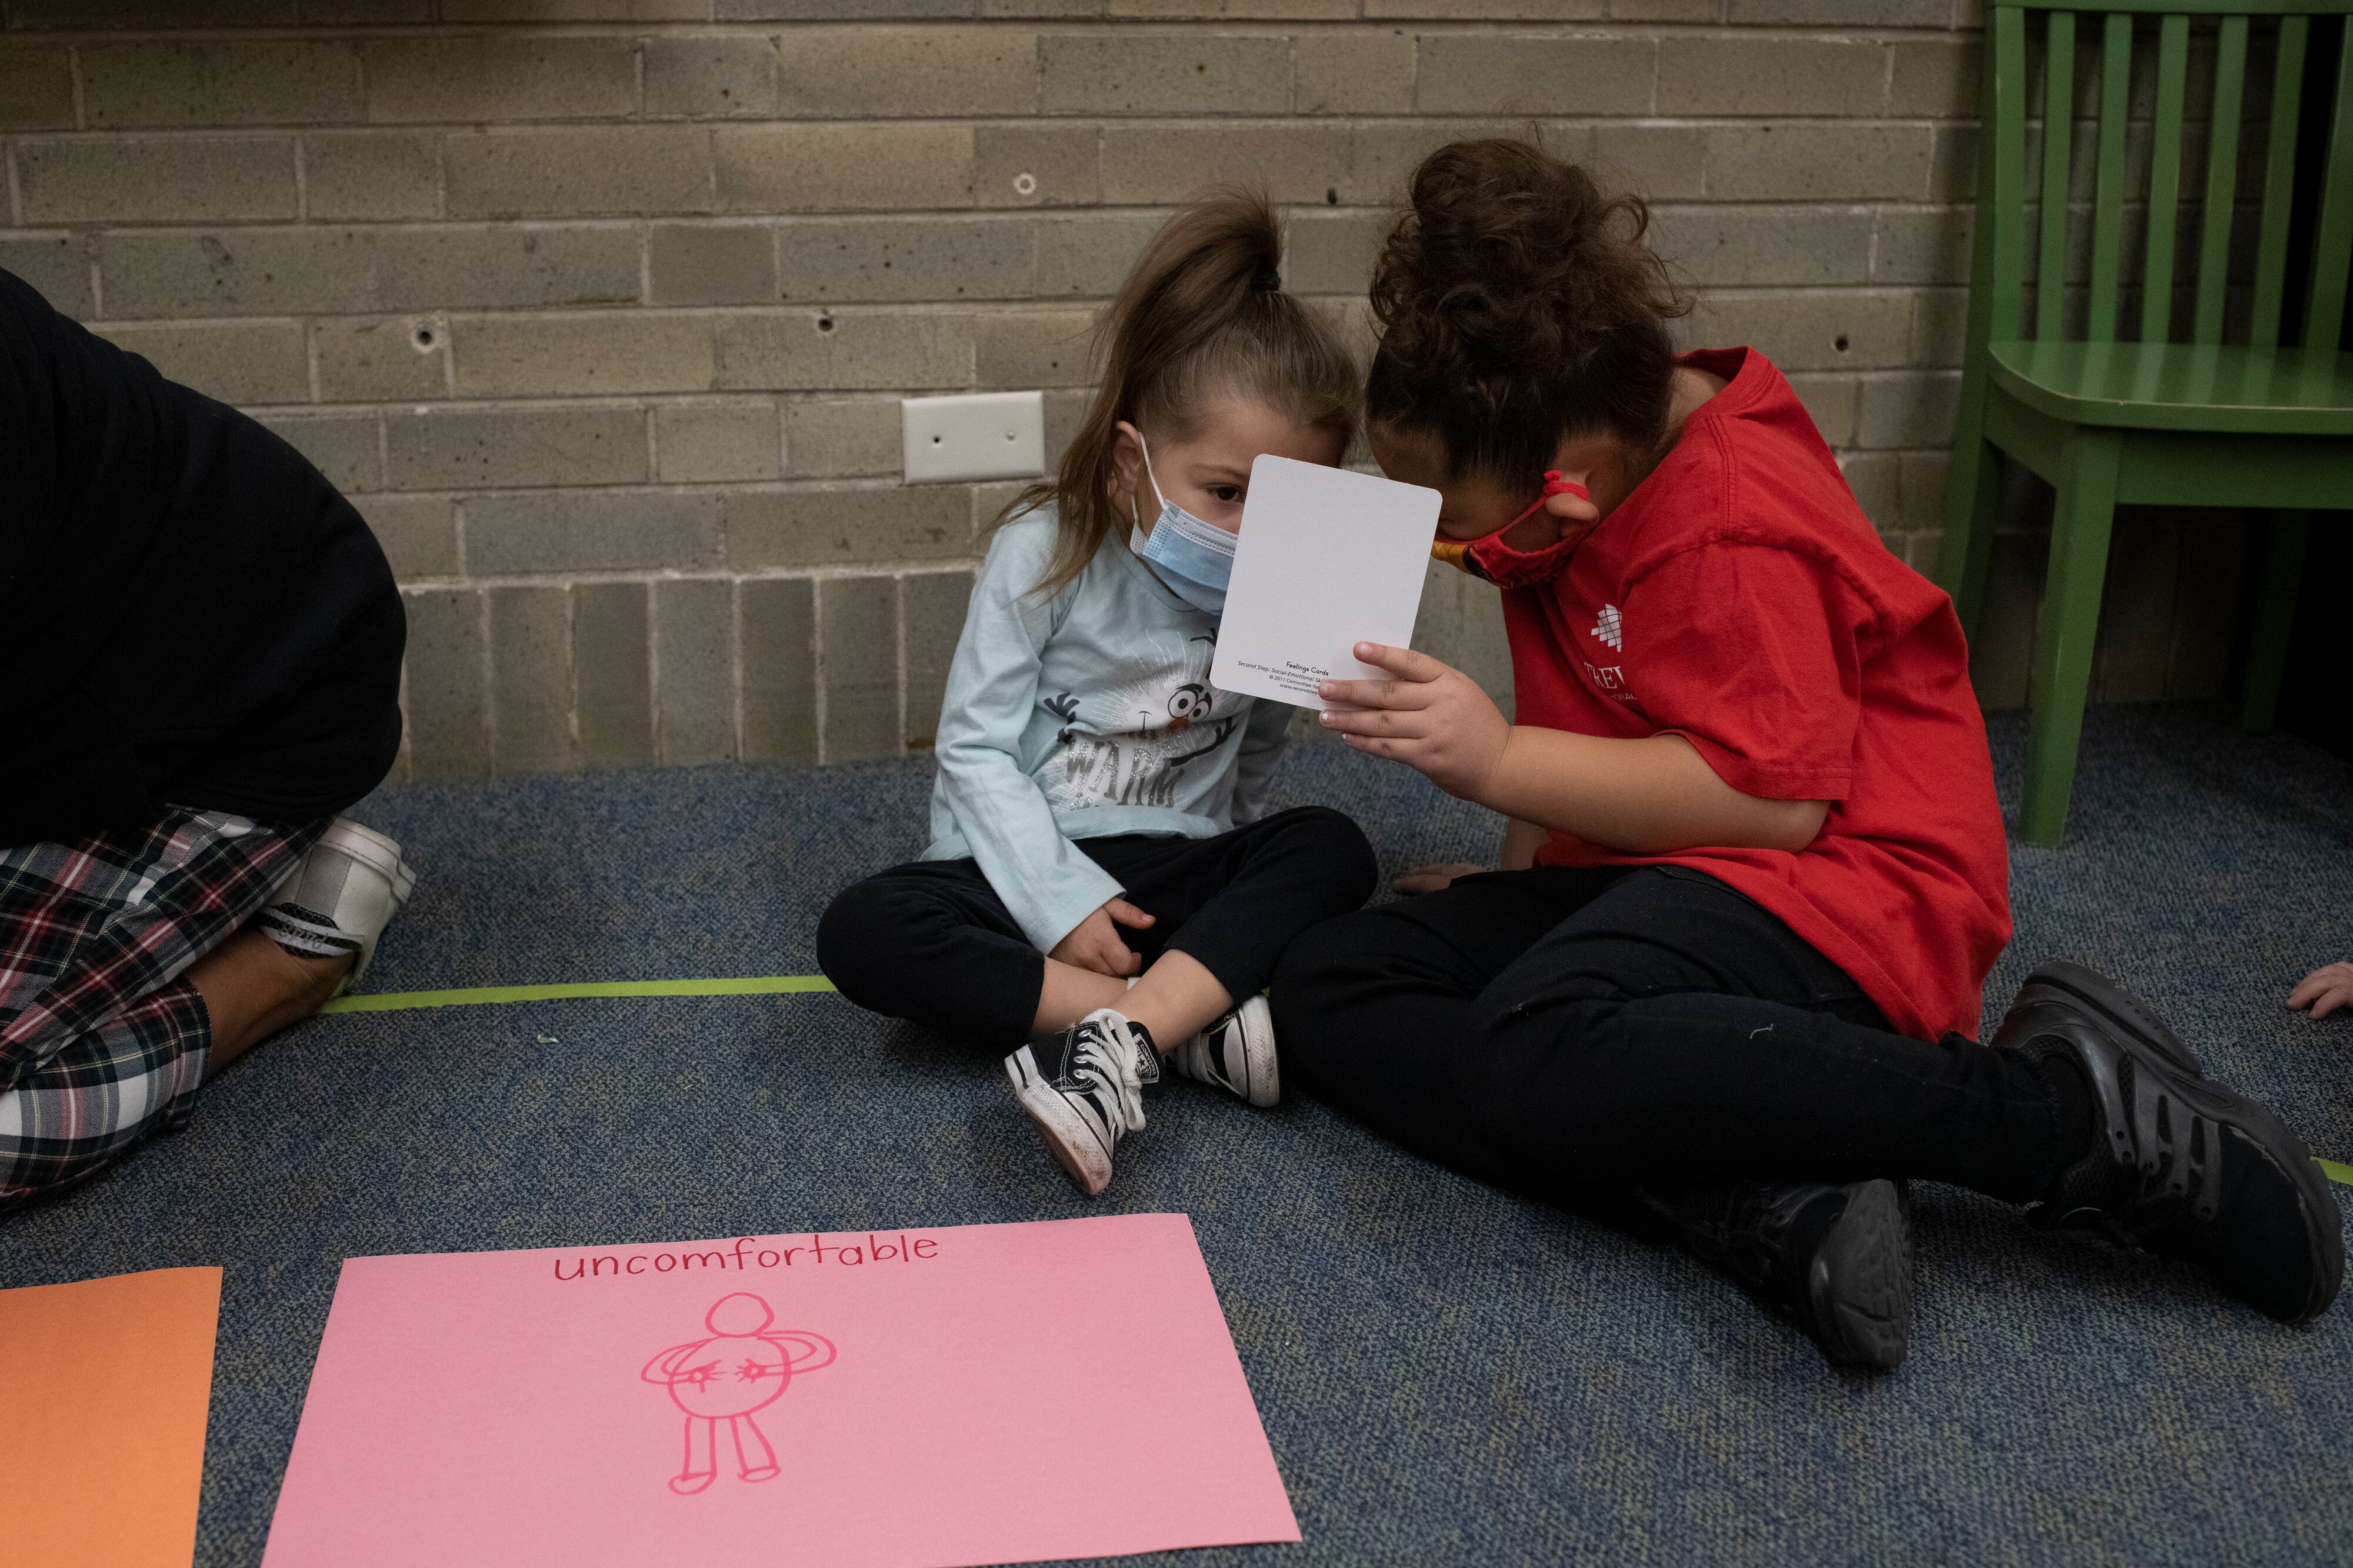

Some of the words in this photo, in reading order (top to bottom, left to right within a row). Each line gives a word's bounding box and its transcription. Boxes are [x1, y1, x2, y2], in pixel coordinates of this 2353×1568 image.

[1237, 660, 1257, 669] Second
[1271, 668, 1315, 681] Social-Emotional
[1286, 661, 1309, 673] Feelings
[1311, 667, 1329, 676] Cards
[1279, 683, 1318, 696] www.secondstep
[1286, 678, 1312, 688] Committee
[1140, 1044, 1156, 1076] CONVERSE
[554, 1234, 939, 1281] uncomfortable
